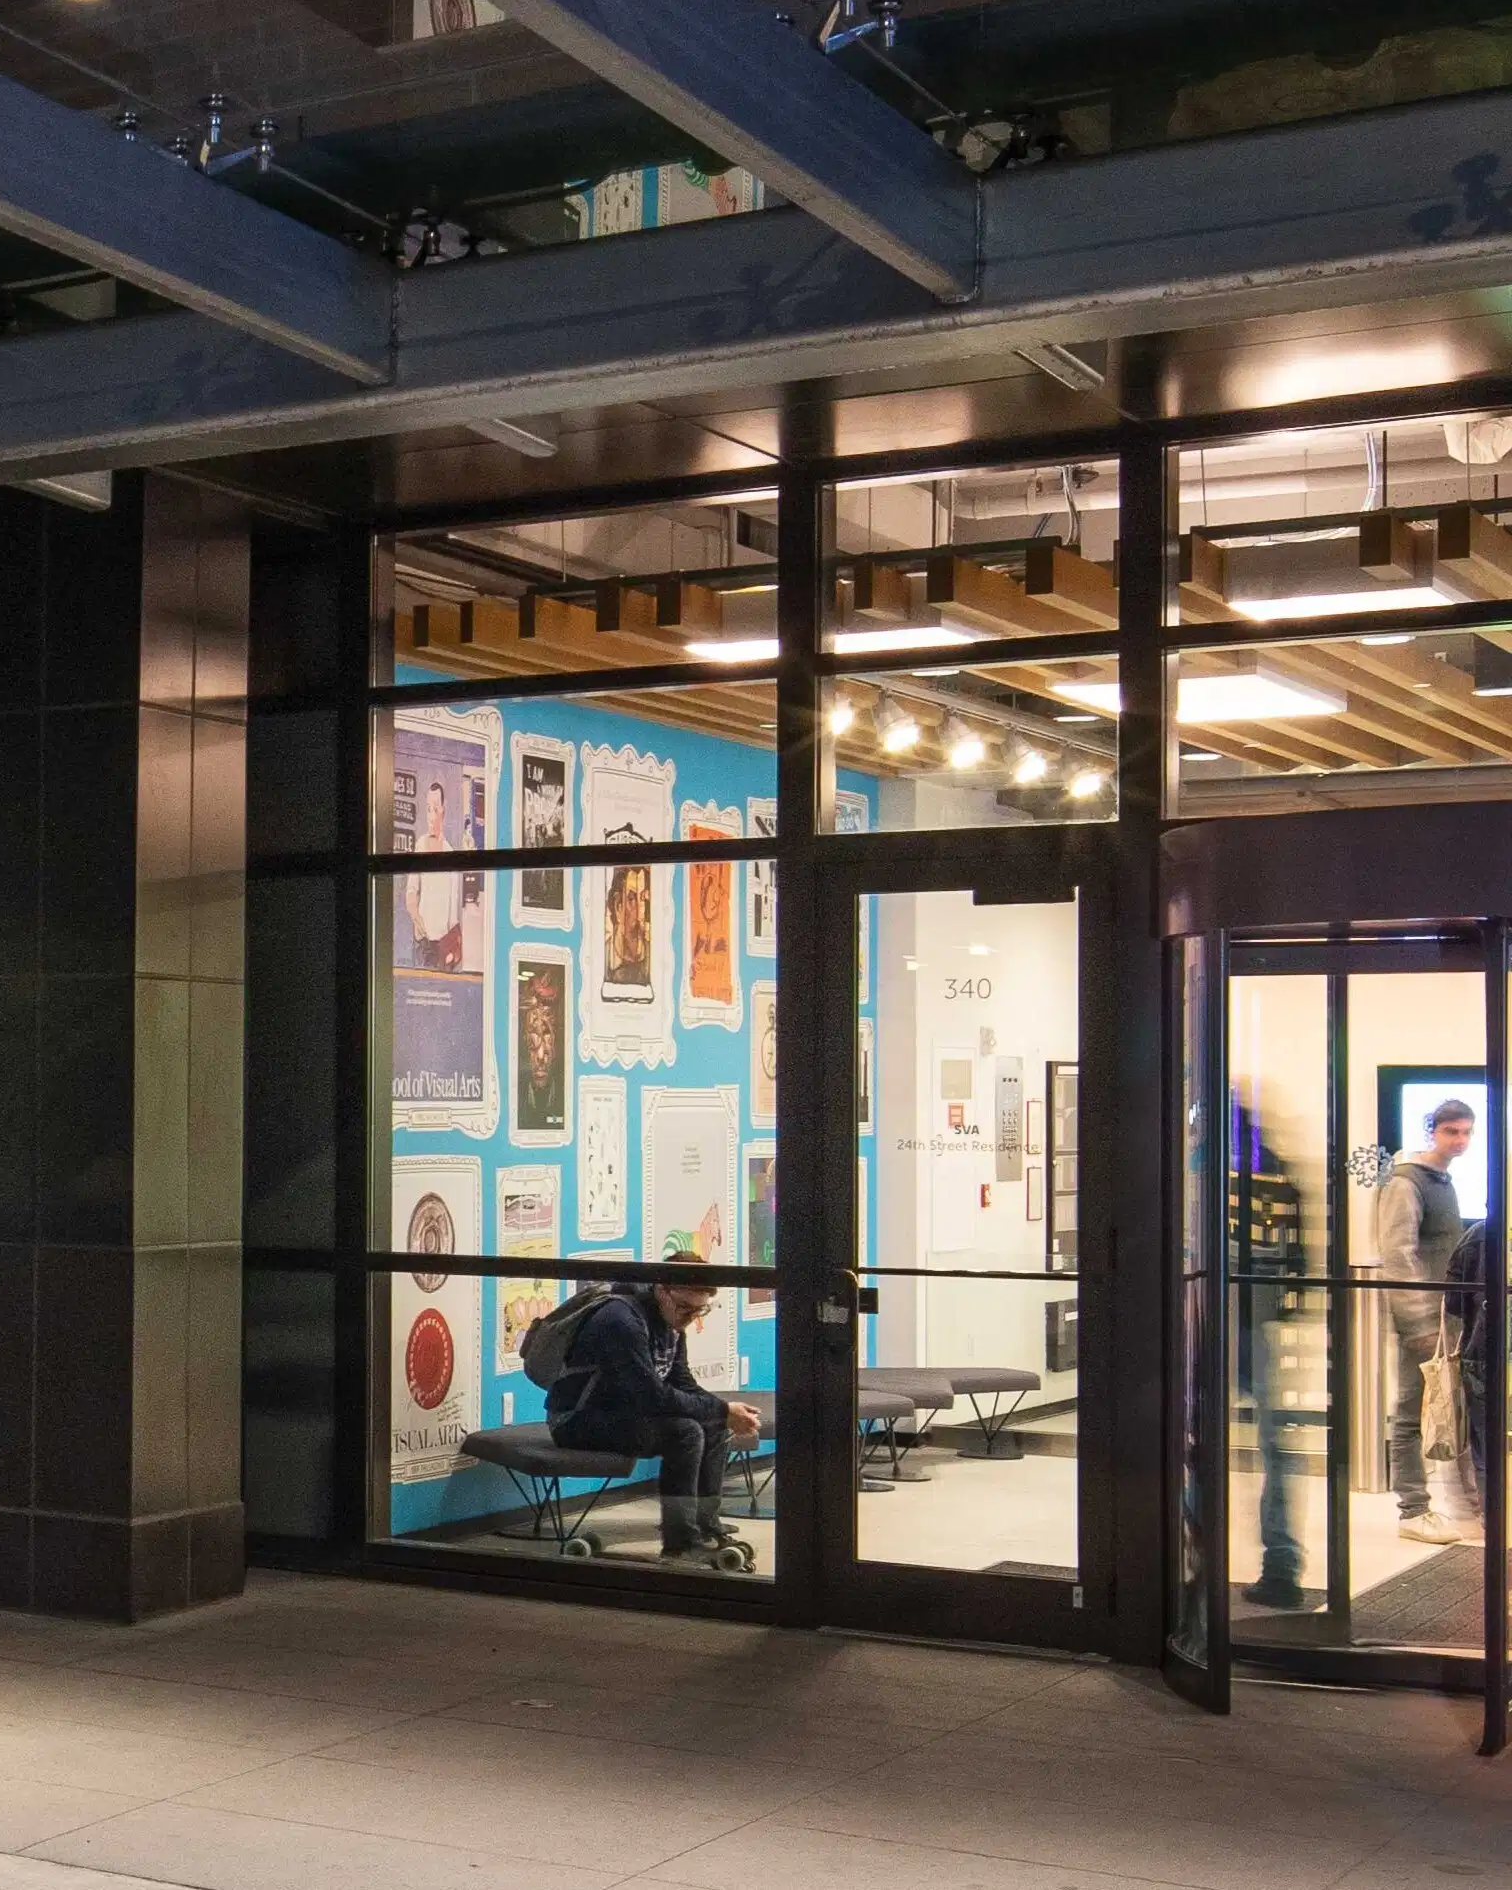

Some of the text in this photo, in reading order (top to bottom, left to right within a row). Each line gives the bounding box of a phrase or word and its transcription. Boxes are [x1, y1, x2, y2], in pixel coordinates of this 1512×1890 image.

[944, 978, 992, 1000] 340
[392, 1070, 481, 1098] ool of Visual Arts
[954, 1124, 980, 1135] SVA
[897, 1138, 1040, 1153] 24th Street Residence
[393, 1422, 469, 1453] ISUAL ARTS
